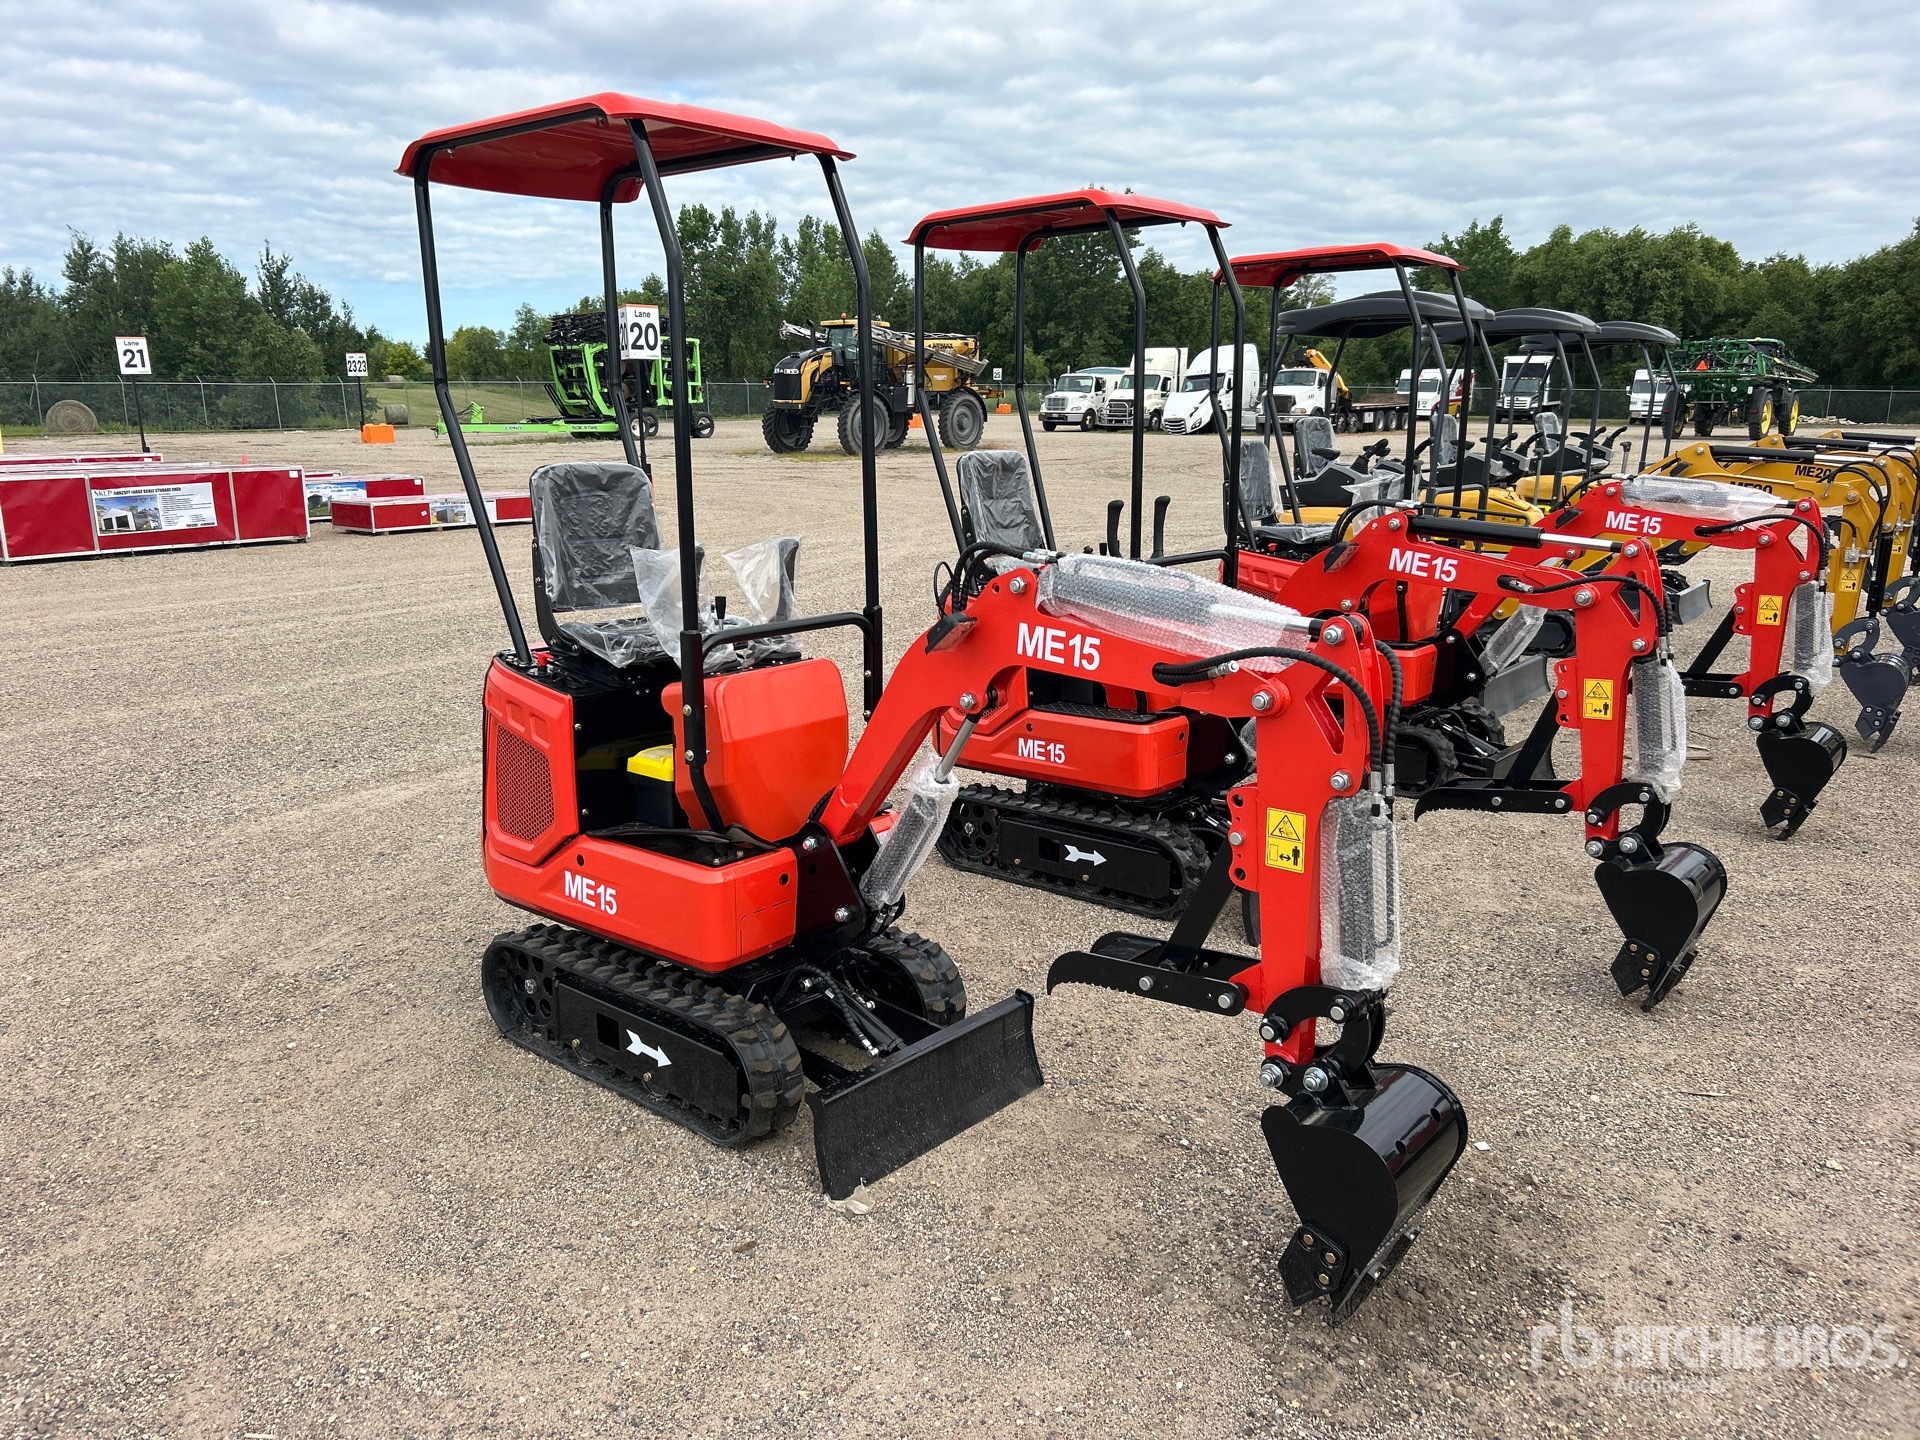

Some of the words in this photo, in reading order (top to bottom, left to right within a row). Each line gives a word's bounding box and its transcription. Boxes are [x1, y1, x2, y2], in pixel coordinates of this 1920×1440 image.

[634, 309, 651, 318] Lane
[630, 322, 658, 351] 20
[122, 348, 146, 368] 21
[347, 360, 357, 373] 23
[357, 360, 367, 373] 23
[994, 371, 1001, 379] 25
[1605, 510, 1662, 535] ME15
[1388, 547, 1458, 582] ME15
[1016, 621, 1101, 671] ME15
[1018, 737, 1066, 764] ME15
[564, 870, 617, 915] ME15
